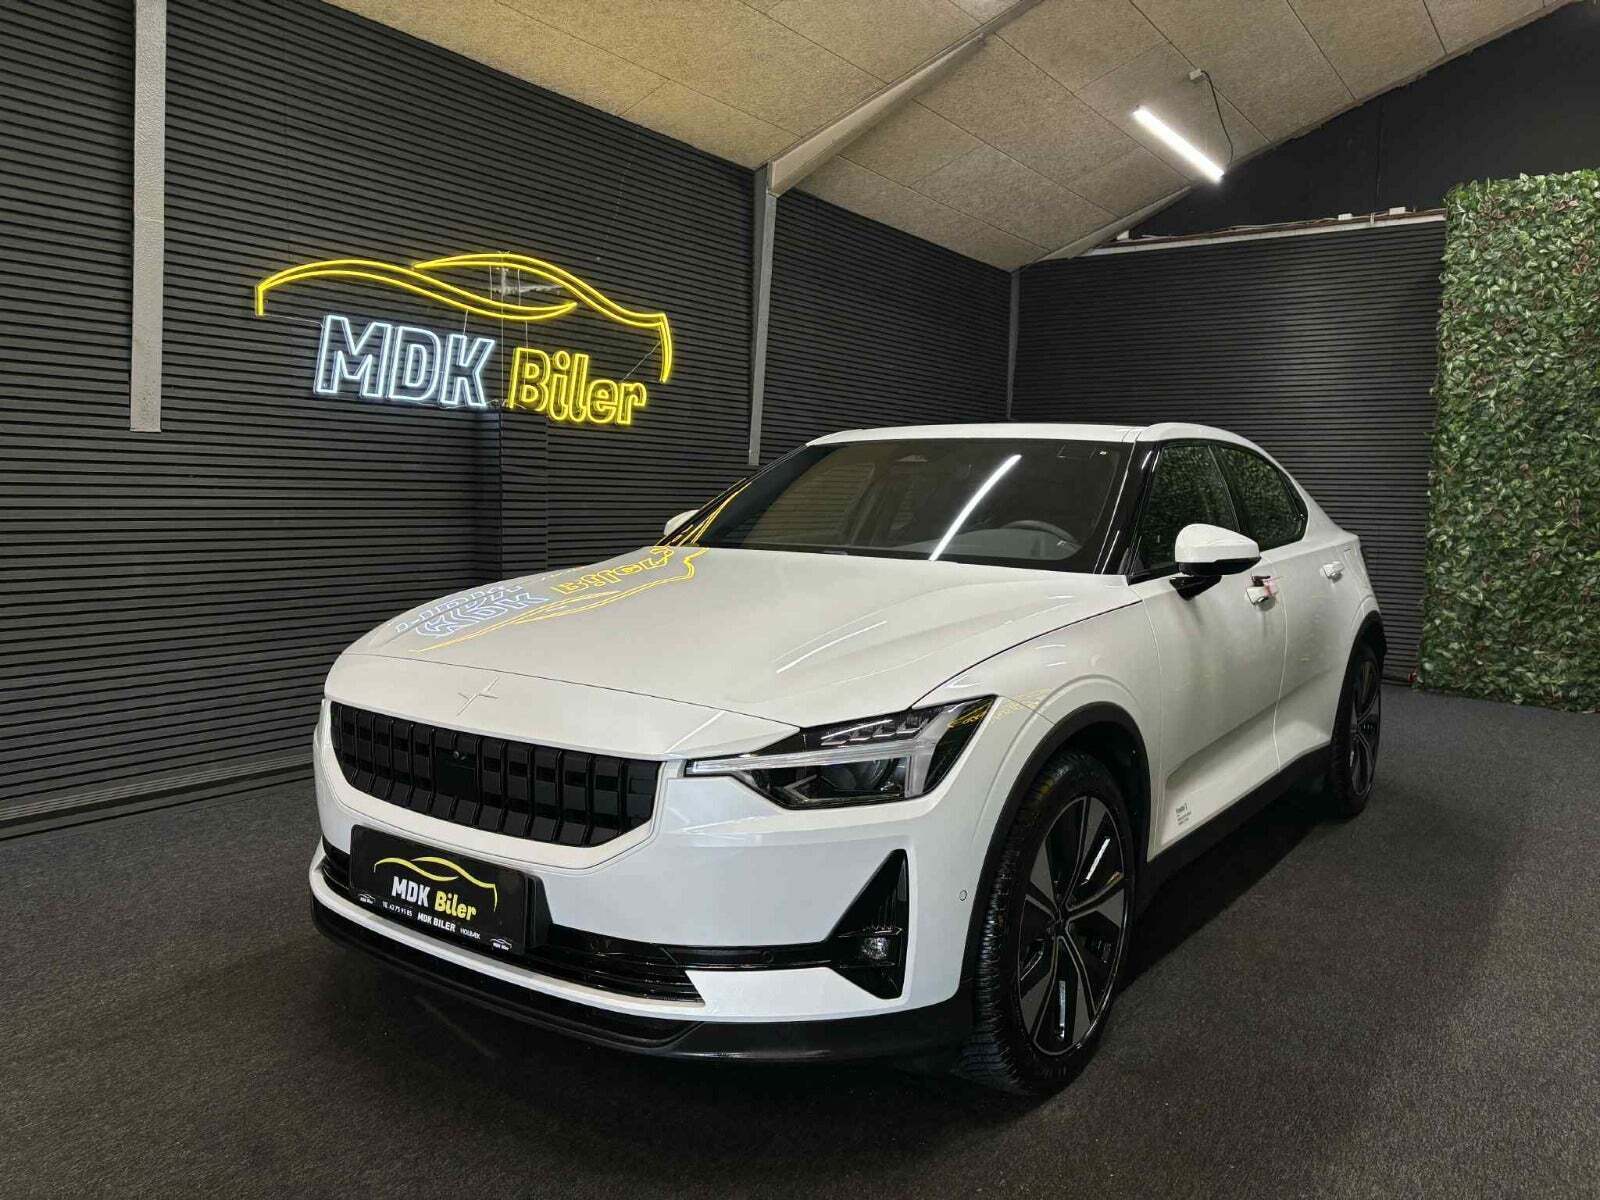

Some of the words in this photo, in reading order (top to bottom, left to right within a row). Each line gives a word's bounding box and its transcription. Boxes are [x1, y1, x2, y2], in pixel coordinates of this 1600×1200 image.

[314, 313, 496, 409] MDK
[508, 346, 648, 426] Biler
[391, 876, 430, 907] MDK
[434, 891, 477, 920] Biler
[417, 912, 433, 925] MDK
[433, 917, 456, 933] BILER
